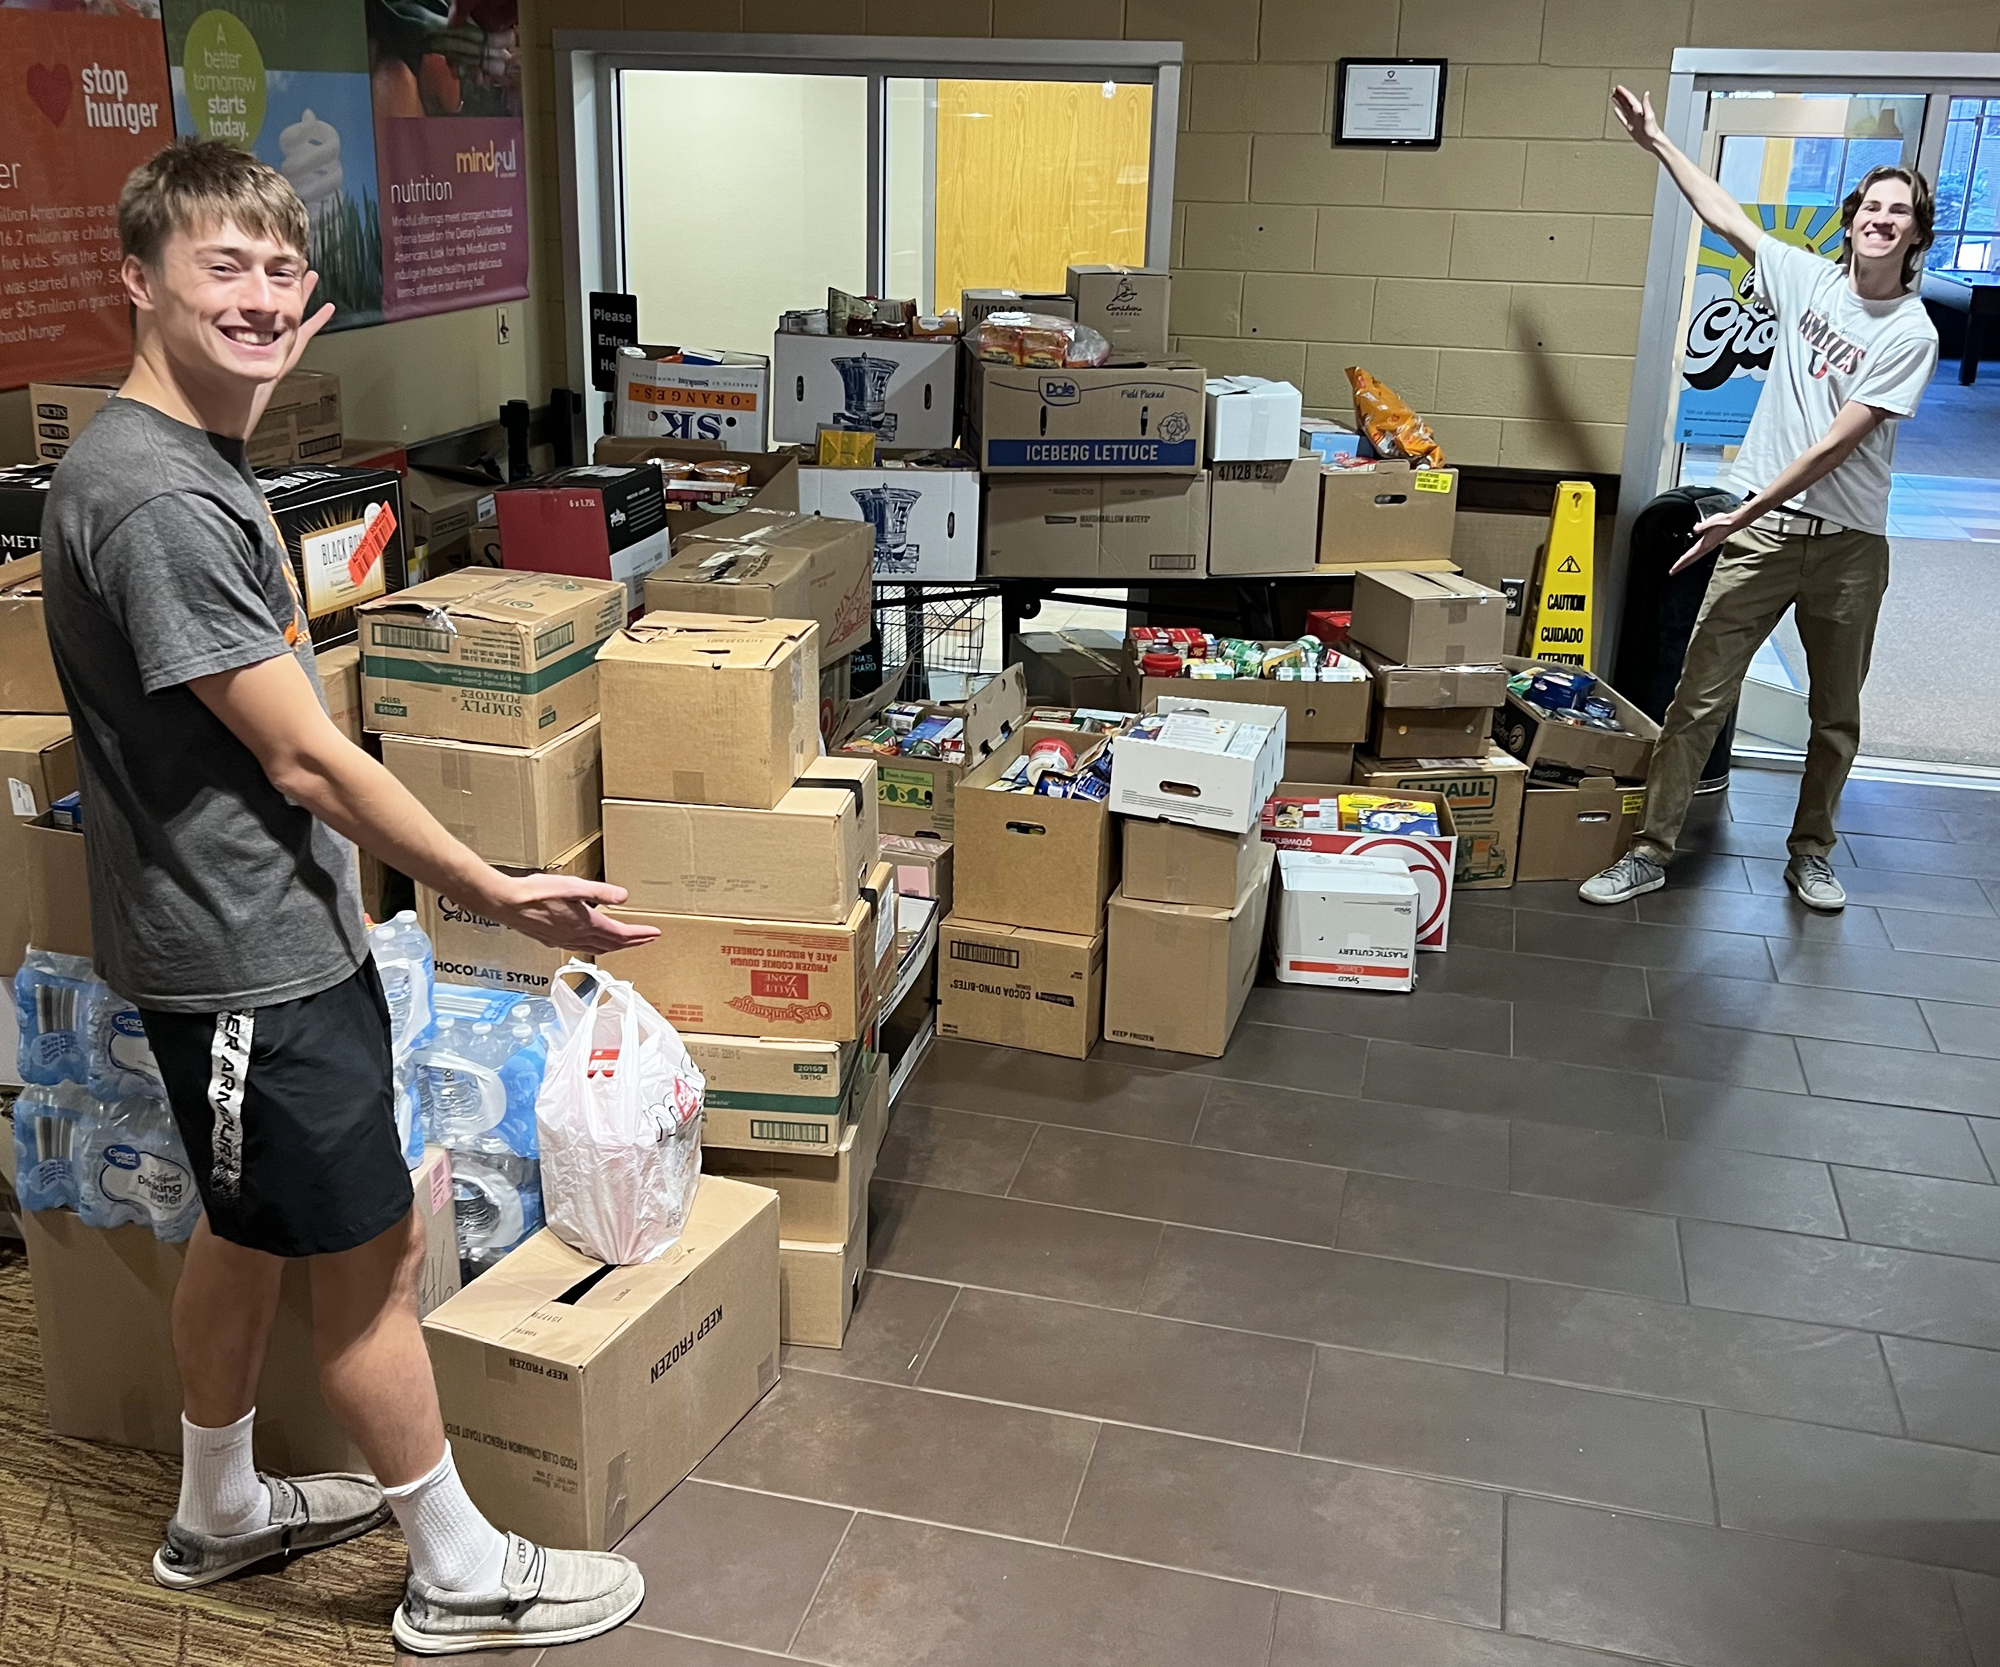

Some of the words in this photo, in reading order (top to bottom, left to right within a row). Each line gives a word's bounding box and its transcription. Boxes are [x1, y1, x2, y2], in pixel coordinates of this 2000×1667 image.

[217, 23, 226, 44] A
[204, 47, 242, 69] better
[81, 62, 129, 101] stop
[193, 73, 256, 92] tomorrow
[208, 94, 246, 114] starts
[85, 95, 158, 135] hunger
[210, 117, 249, 142] today.
[456, 139, 516, 178] mindful
[0, 162, 21, 189] er
[391, 174, 452, 204] nutrition
[0, 206, 28, 222] illion
[30, 203, 84, 221] Americans
[87, 205, 104, 217] are
[392, 214, 416, 227] Mindful
[416, 212, 444, 227] offerings
[444, 212, 460, 222] meet
[26, 231, 60, 245] million
[82, 225, 121, 240] childre
[80, 250, 97, 263] the
[100, 246, 122, 262] Sod
[28, 277, 68, 292] started
[16, 300, 37, 318] $25
[38, 299, 75, 315] million
[90, 293, 120, 313] grants
[1106, 303, 1142, 313] Caribou
[594, 308, 632, 323] Please
[598, 333, 629, 347] Enter
[601, 359, 617, 371] He
[644, 387, 741, 405] ORANGES
[1046, 382, 1075, 397] Dole
[1121, 389, 1138, 399] Field
[1140, 389, 1165, 399] Packed
[1026, 445, 1090, 461] ICEBERG
[1094, 445, 1159, 461] LETTUCE
[1218, 464, 1251, 481] 4/128
[1080, 515, 1124, 523] MARSHMALLOW
[321, 538, 347, 565] BLACK
[349, 533, 362, 558] BO
[1548, 594, 1586, 611] CAUTION
[1541, 626, 1583, 643] CUIDADO
[851, 655, 873, 663] THA'S
[851, 662, 877, 674] CHARD
[460, 689, 521, 705] POTATOES
[460, 700, 521, 718] SIMPLY
[720, 945, 764, 957] CONGELÉE
[767, 948, 805, 959] BISCUITS
[816, 952, 837, 963] PÂTE
[1338, 948, 1374, 957] CUTLERY
[1375, 951, 1408, 959] PLASTIC
[730, 958, 760, 968] DOUGH
[762, 960, 793, 970] COOKIE
[795, 962, 828, 973] FROZEN
[1335, 965, 1364, 974] Classic
[434, 960, 502, 980] HOCOLATE
[507, 971, 549, 986] SYRUP
[1338, 976, 1360, 985] Sysco
[1003, 987, 1031, 1000] COCOA
[724, 996, 805, 1024] Spunkmeyer
[804, 1002, 832, 1021] Otis
[116, 1016, 143, 1027] Grea
[1129, 1032, 1154, 1042] FROZEN
[216, 1055, 236, 1160] ARMOUR
[107, 1148, 136, 1160] Great
[116, 1157, 137, 1167] Value
[138, 1174, 182, 1195] Drinking
[150, 1189, 183, 1205] Water
[697, 1304, 723, 1341] KEEP
[651, 1331, 694, 1384] FROZEN
[509, 1357, 544, 1375] FROZEN
[546, 1368, 569, 1382] KEEP
[461, 1427, 482, 1443] TOAST
[482, 1433, 508, 1450] FRENCH
[508, 1441, 540, 1459] CINNAMON
[542, 1451, 559, 1465] CLUB
[560, 1456, 577, 1470] FOOD
